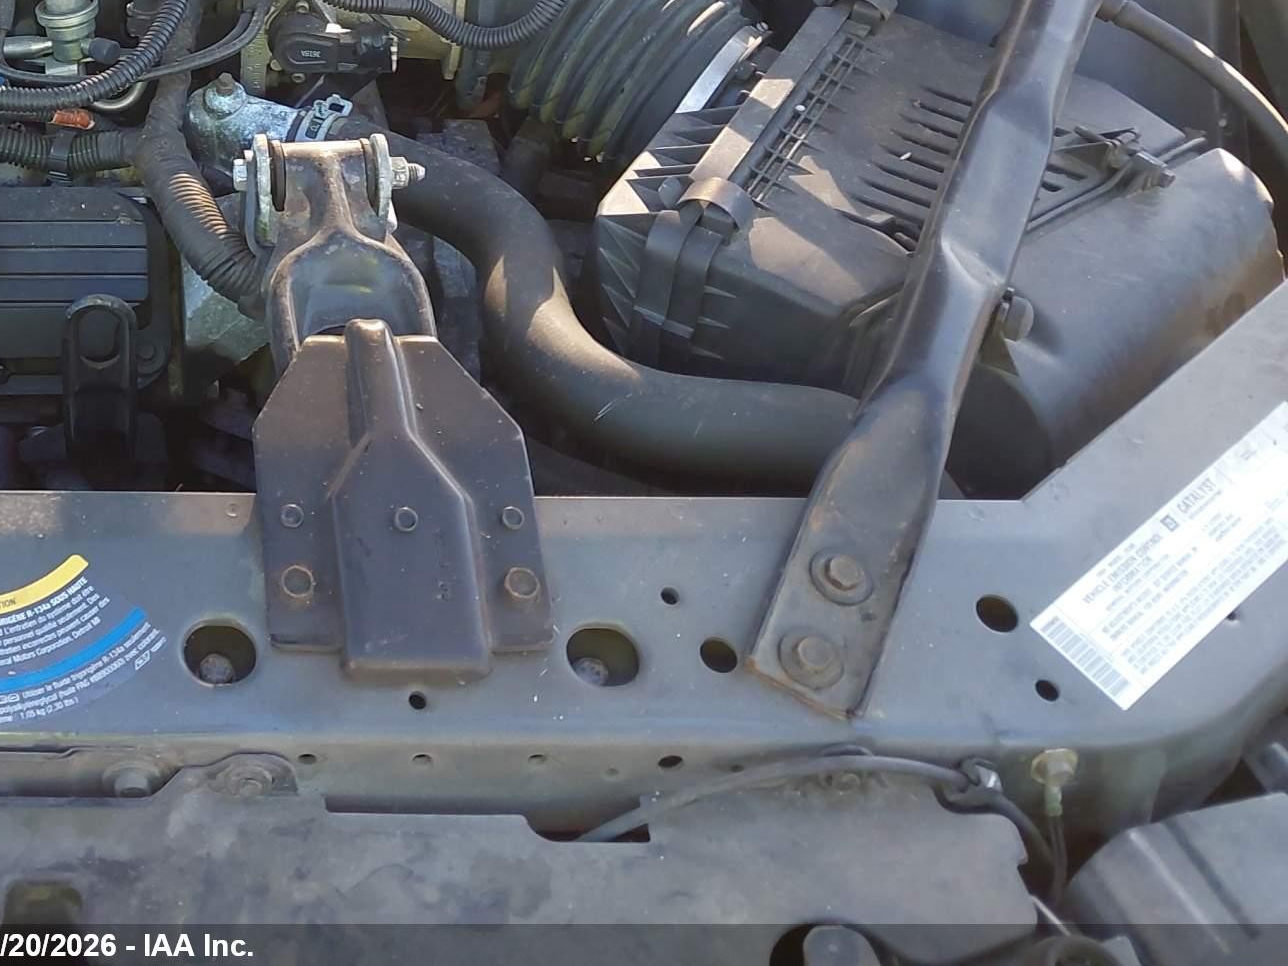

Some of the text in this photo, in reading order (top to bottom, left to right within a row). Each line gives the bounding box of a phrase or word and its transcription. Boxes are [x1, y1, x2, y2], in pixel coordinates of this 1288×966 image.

[1176, 477, 1216, 513] CATALYST
[26, 601, 51, 617] R-134a
[49, 590, 69, 606] SOUS
[66, 575, 88, 595] HAUTE
[37, 614, 46, 623] du
[70, 593, 82, 605] doit
[79, 605, 99, 622] causer
[97, 596, 110, 608] des
[3, 631, 35, 646] personnel
[86, 591, 100, 605] Des
[12, 650, 36, 663] Motors
[52, 676, 70, 689] fluide
[102, 644, 124, 663] R-134a
[122, 621, 151, 648] seulement
[75, 678, 90, 690] PAG
[123, 647, 138, 661] avec
